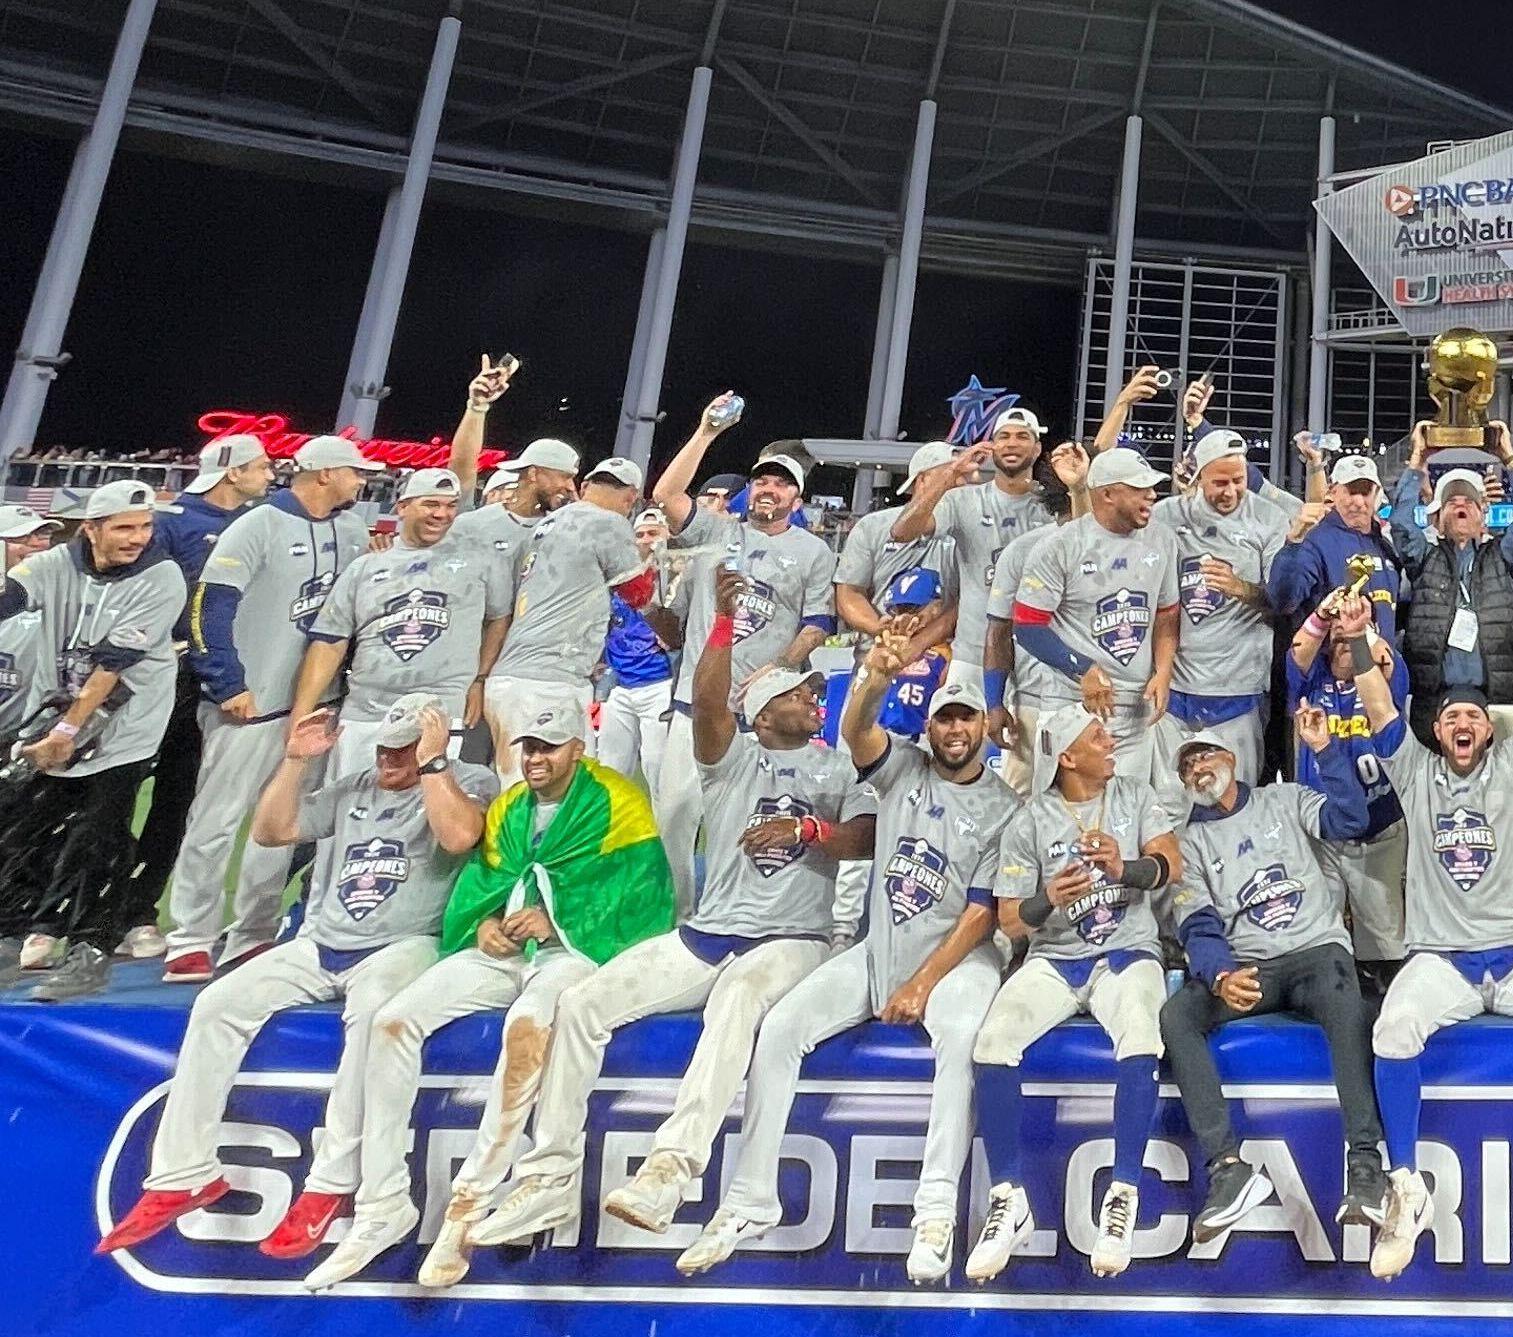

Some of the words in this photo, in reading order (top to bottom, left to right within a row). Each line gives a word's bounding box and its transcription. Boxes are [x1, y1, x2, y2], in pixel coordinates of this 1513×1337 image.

[1443, 282, 1498, 303] HEALTH
[1093, 609, 1149, 632] CAMPEONES
[897, 682, 925, 706] 45
[1067, 886, 1122, 921] CAMPEON
